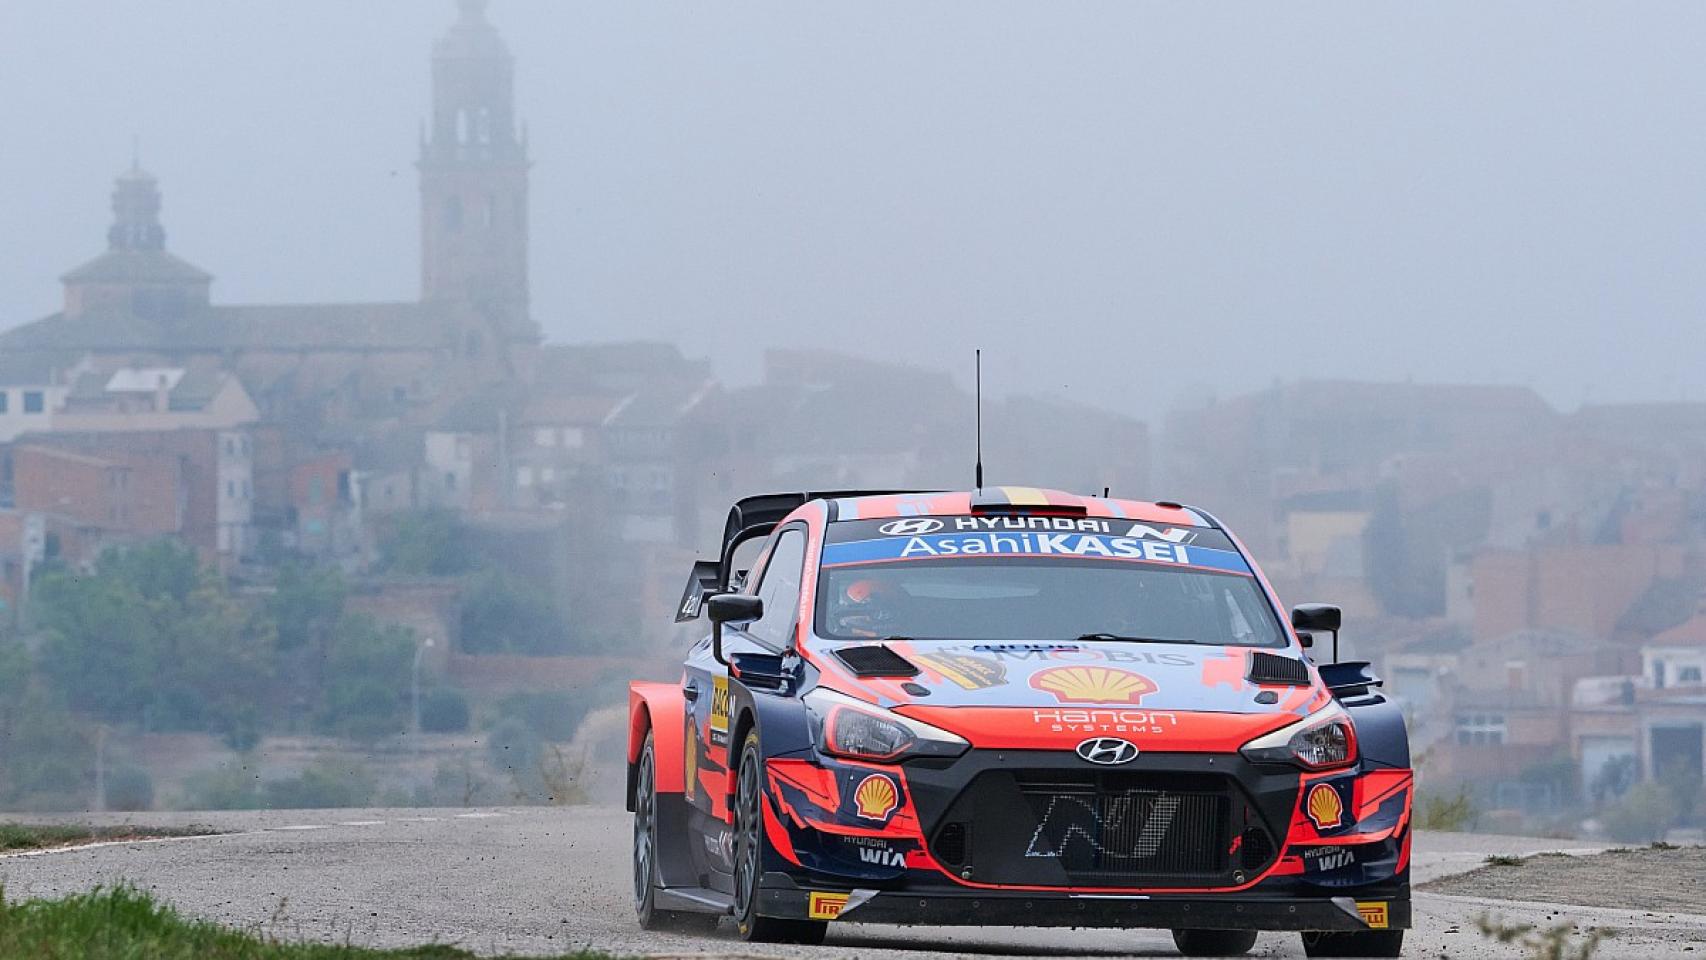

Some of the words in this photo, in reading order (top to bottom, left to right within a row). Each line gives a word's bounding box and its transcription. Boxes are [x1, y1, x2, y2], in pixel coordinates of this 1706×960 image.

[955, 516, 1110, 533] HYUNDAI
[993, 648, 1196, 667] MOBIS
[1033, 710, 1177, 725] Hanon
[1051, 724, 1163, 733] SYSTEMS
[844, 836, 887, 849] HYUNDAI
[815, 897, 848, 914] PIR
